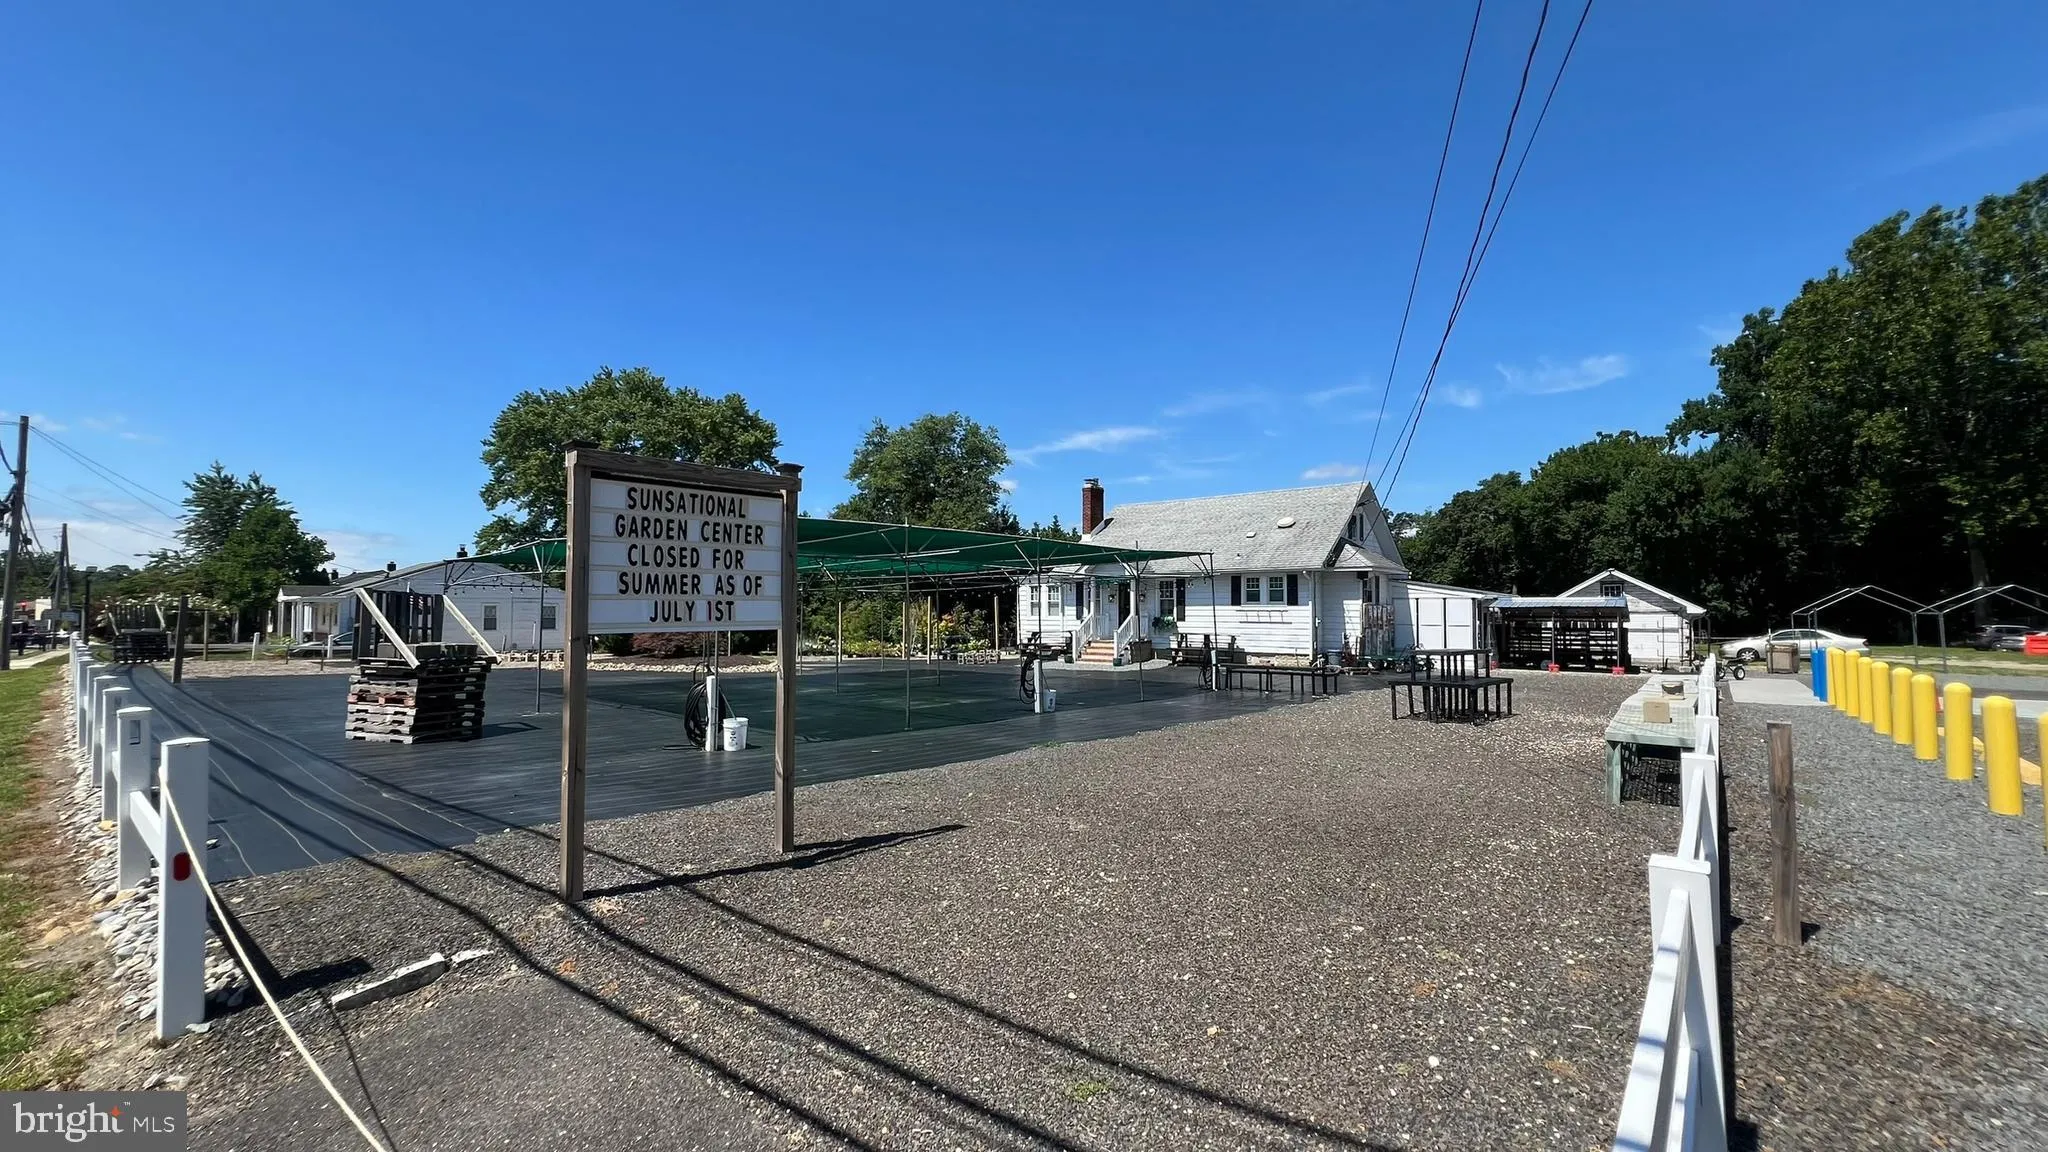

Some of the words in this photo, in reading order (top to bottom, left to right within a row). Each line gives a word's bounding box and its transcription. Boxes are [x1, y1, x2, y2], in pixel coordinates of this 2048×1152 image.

[627, 487, 746, 519] SUNSATIONAL
[615, 514, 688, 541] GARDEN
[700, 521, 764, 545] CENTER
[627, 544, 700, 568] CLOSED
[712, 549, 744, 570] FOR
[618, 572, 701, 595] SUMMER
[715, 575, 735, 596] AS
[743, 576, 763, 596] OF
[650, 601, 695, 623] JULY
[708, 601, 735, 622] 1ST
